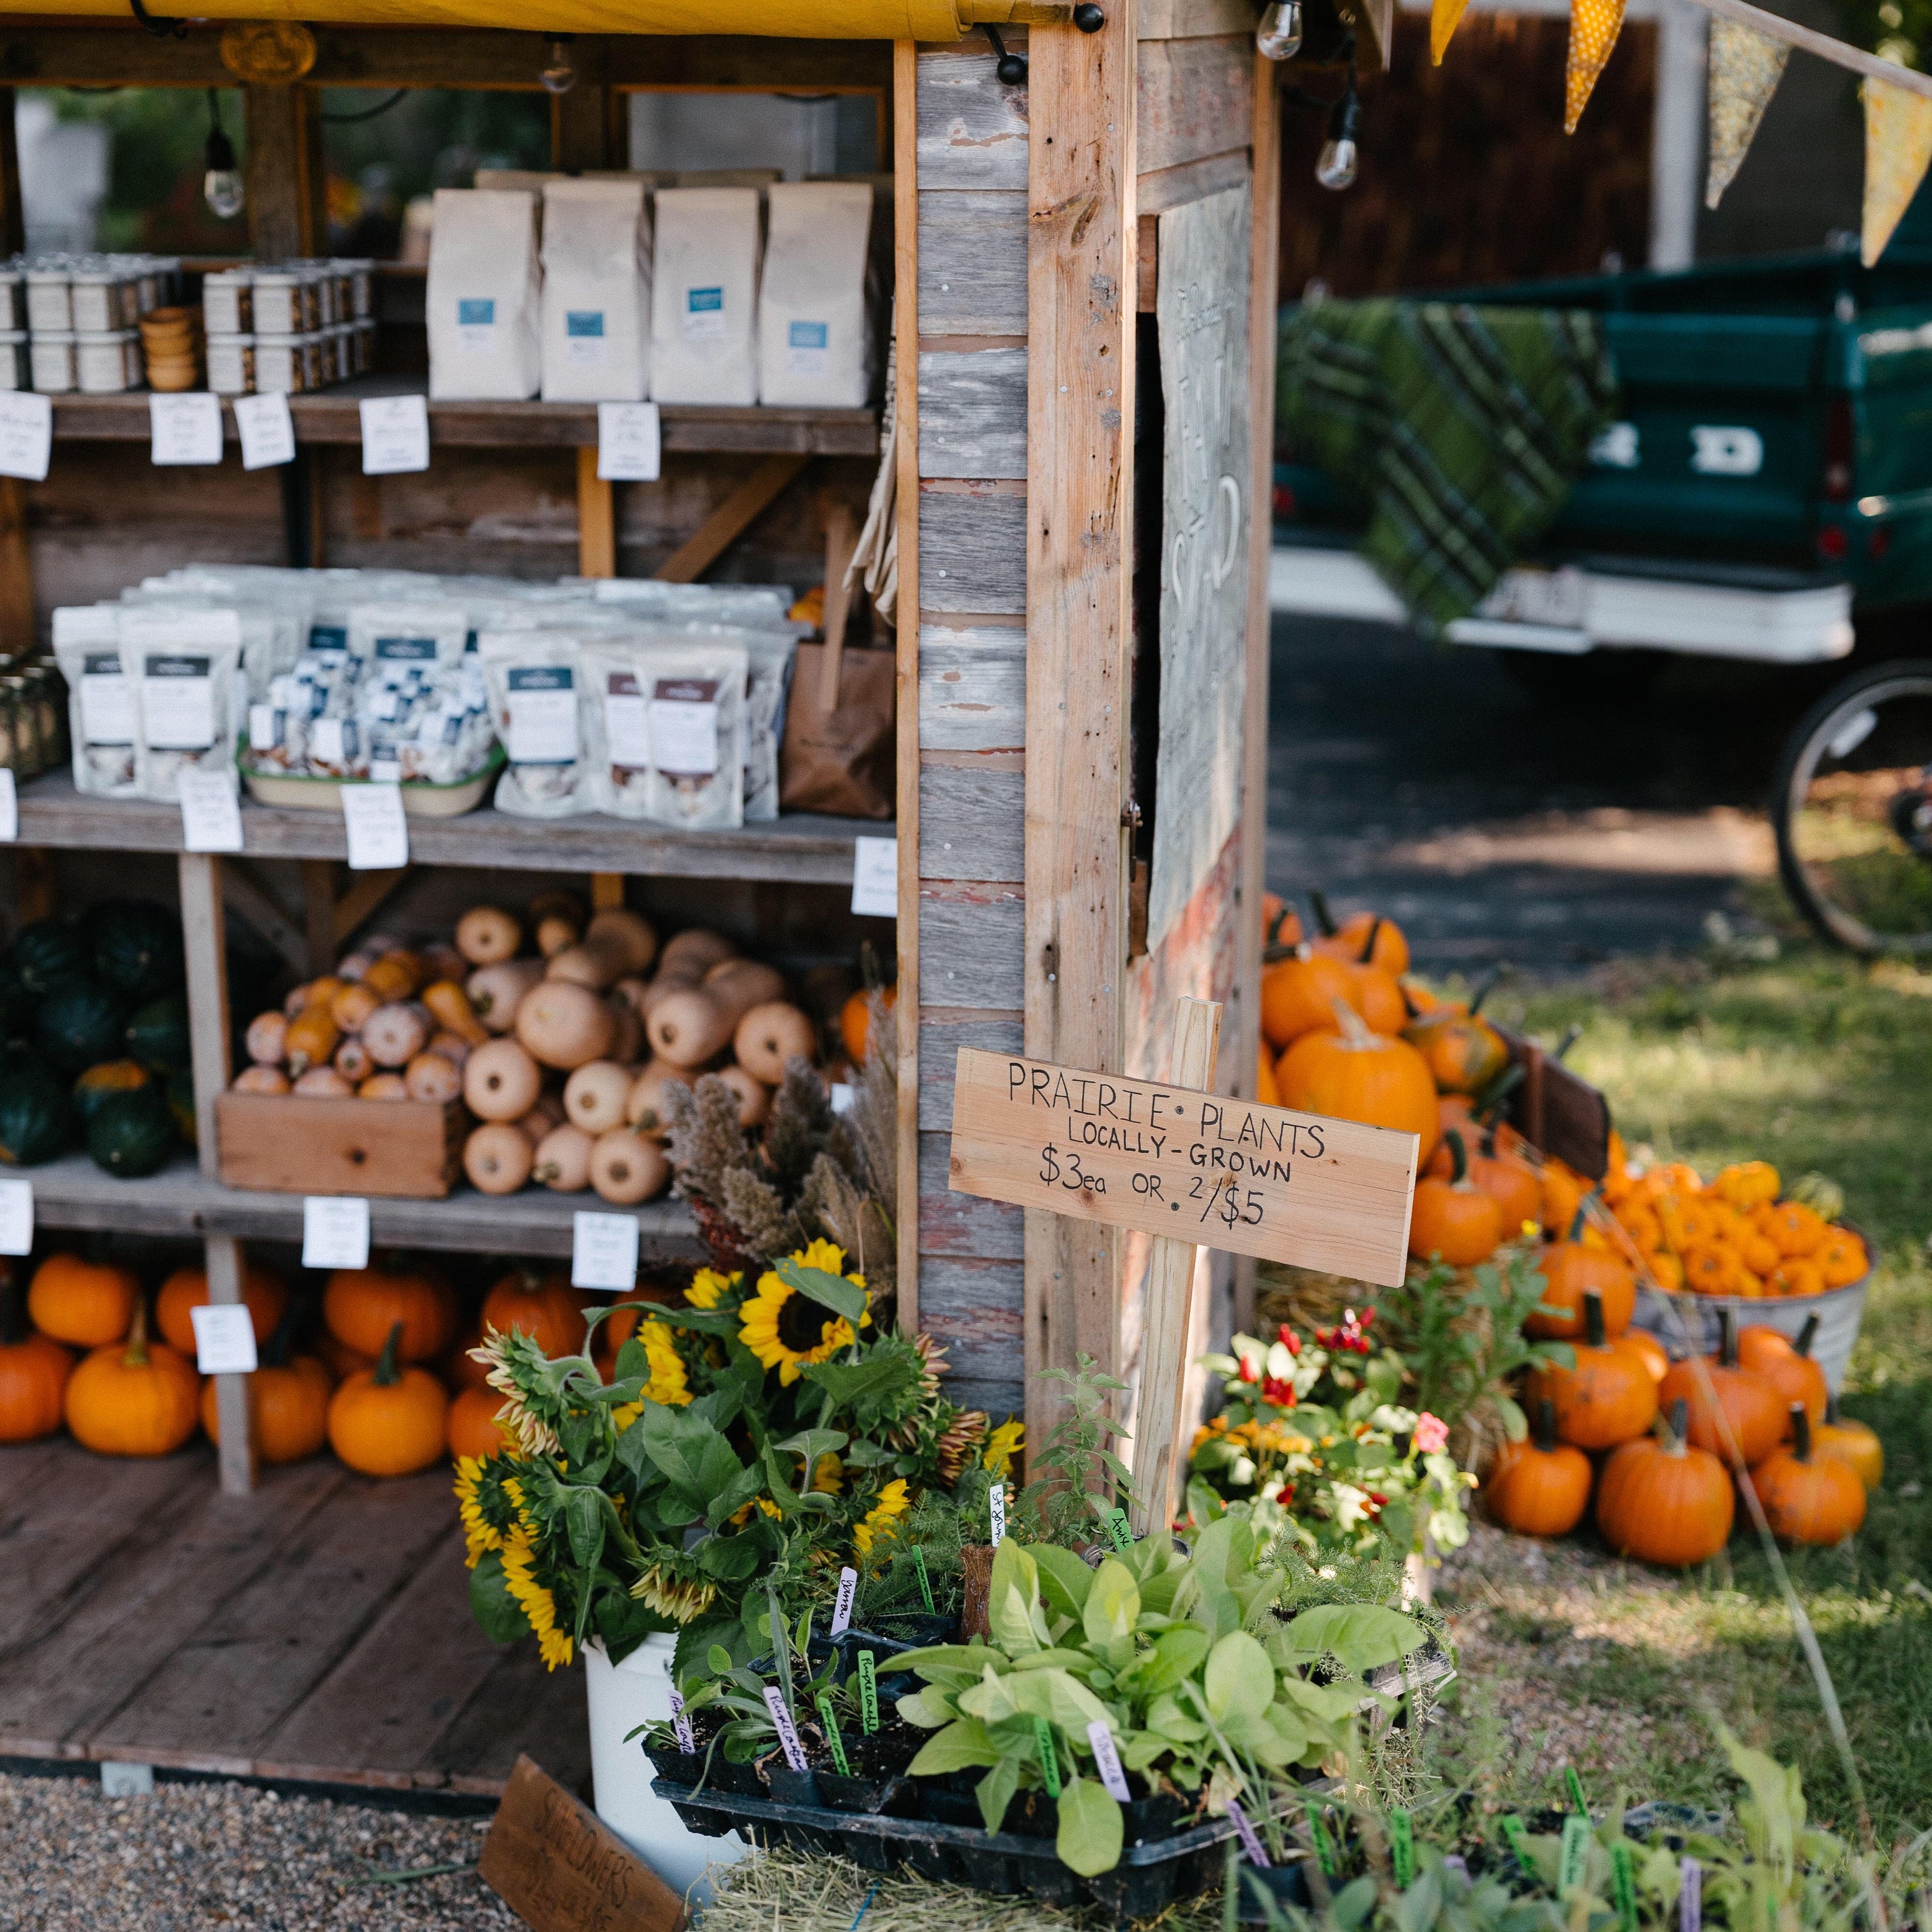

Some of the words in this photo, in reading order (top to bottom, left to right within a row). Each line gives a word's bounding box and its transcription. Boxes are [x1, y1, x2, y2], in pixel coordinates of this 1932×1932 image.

[1009, 1062, 1170, 1131] PRAIRIE
[1201, 1102, 1325, 1159] PLANTS
[1040, 1142, 1106, 1194] $3ea
[1132, 1172, 1165, 1202] OR
[1188, 1176, 1264, 1230] 2/$5
[862, 1657, 873, 1693] Purple
